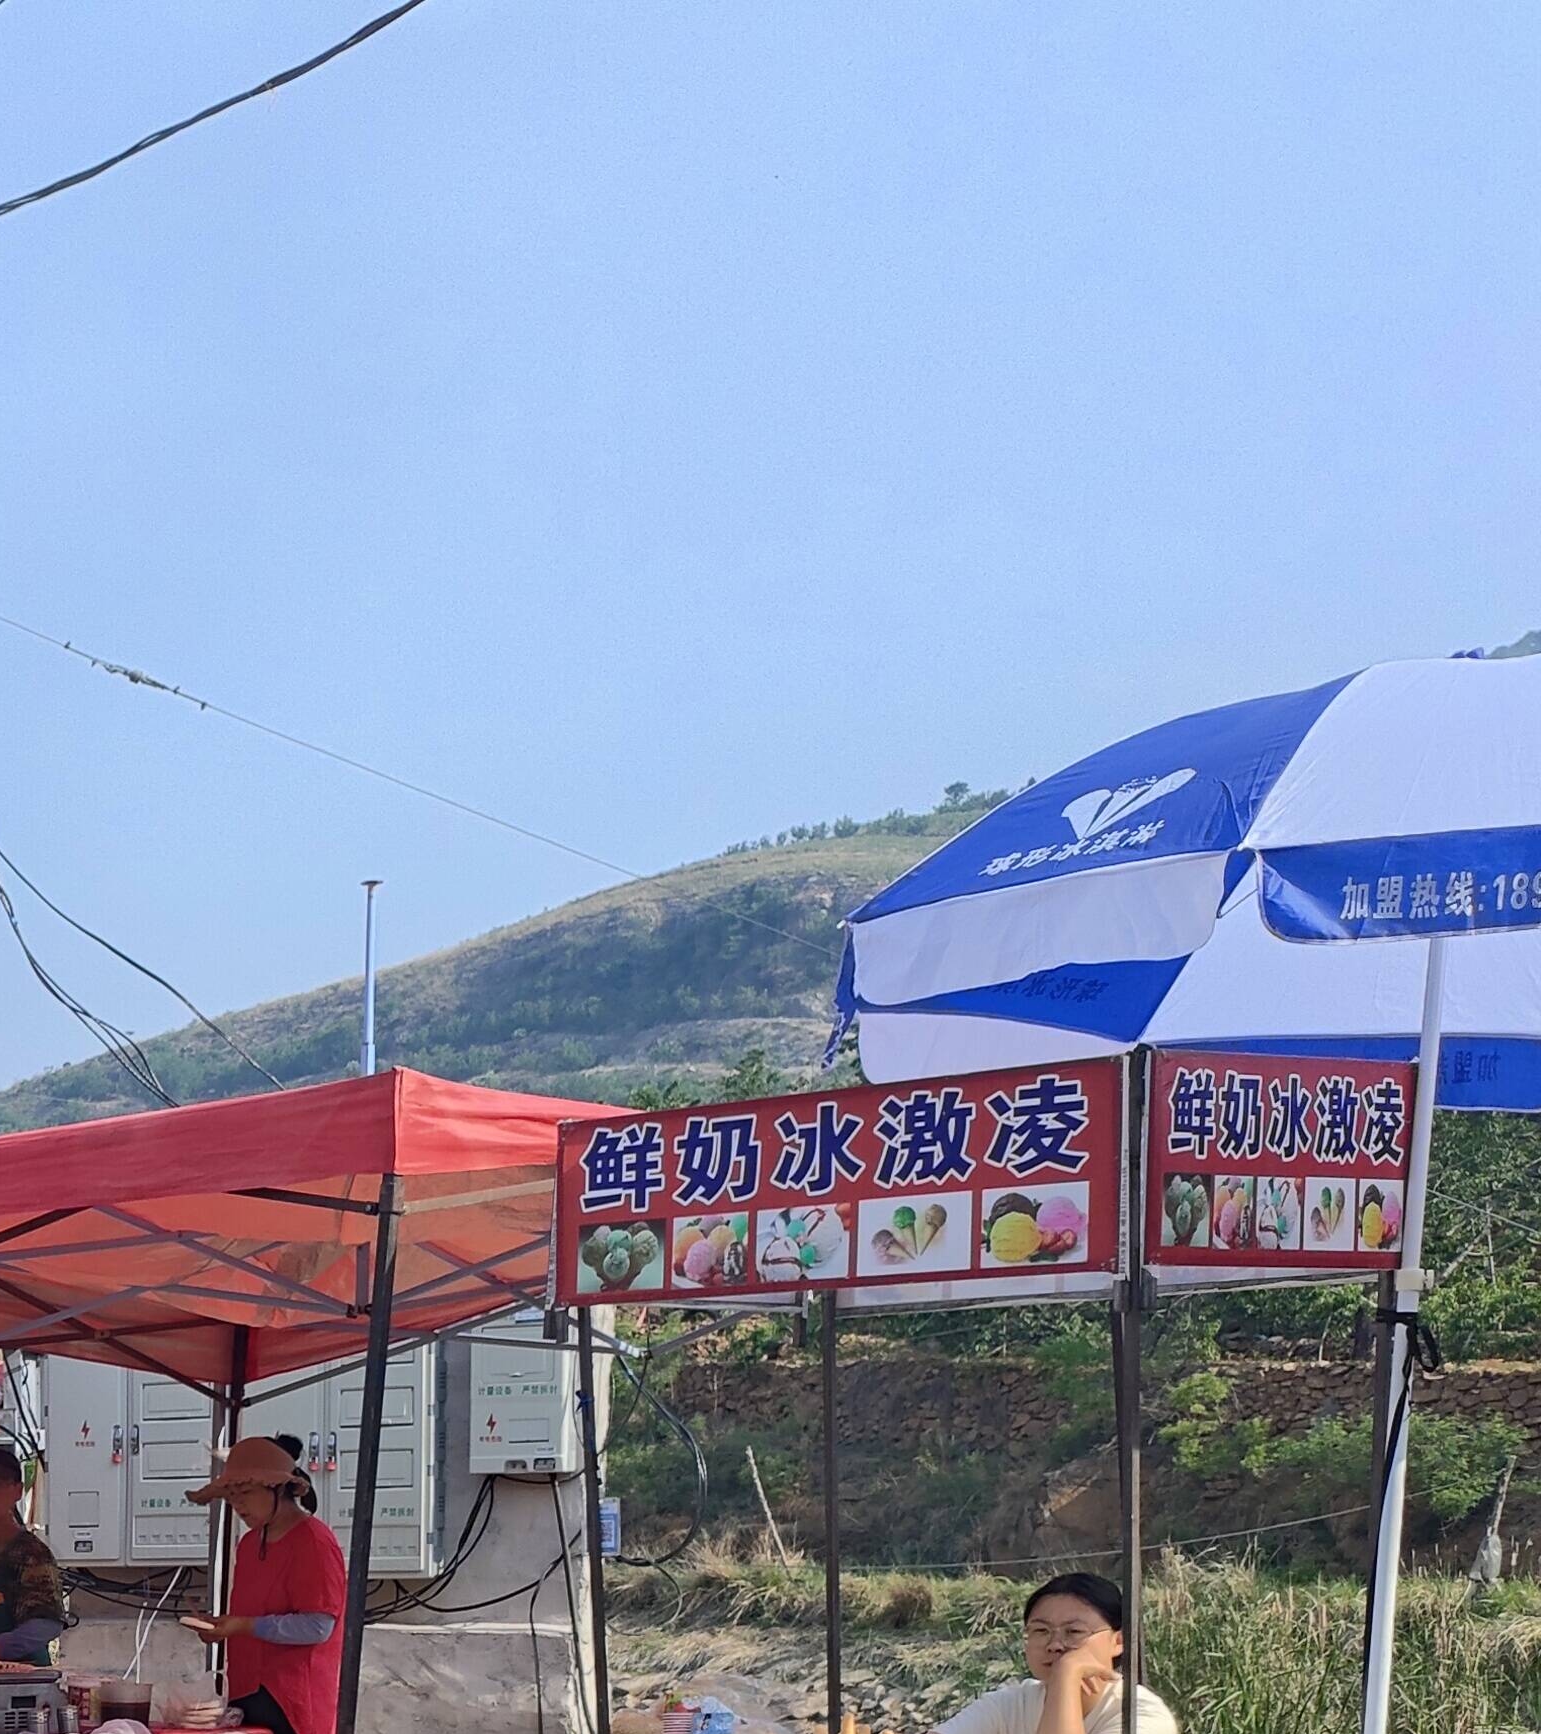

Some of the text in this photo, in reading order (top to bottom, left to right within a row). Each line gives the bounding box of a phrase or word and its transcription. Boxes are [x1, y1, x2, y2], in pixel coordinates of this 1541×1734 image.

[579, 1073, 1091, 1215] 鲜奶冰激凌
[1168, 1064, 1405, 1167] 鲜奶冰激凌
